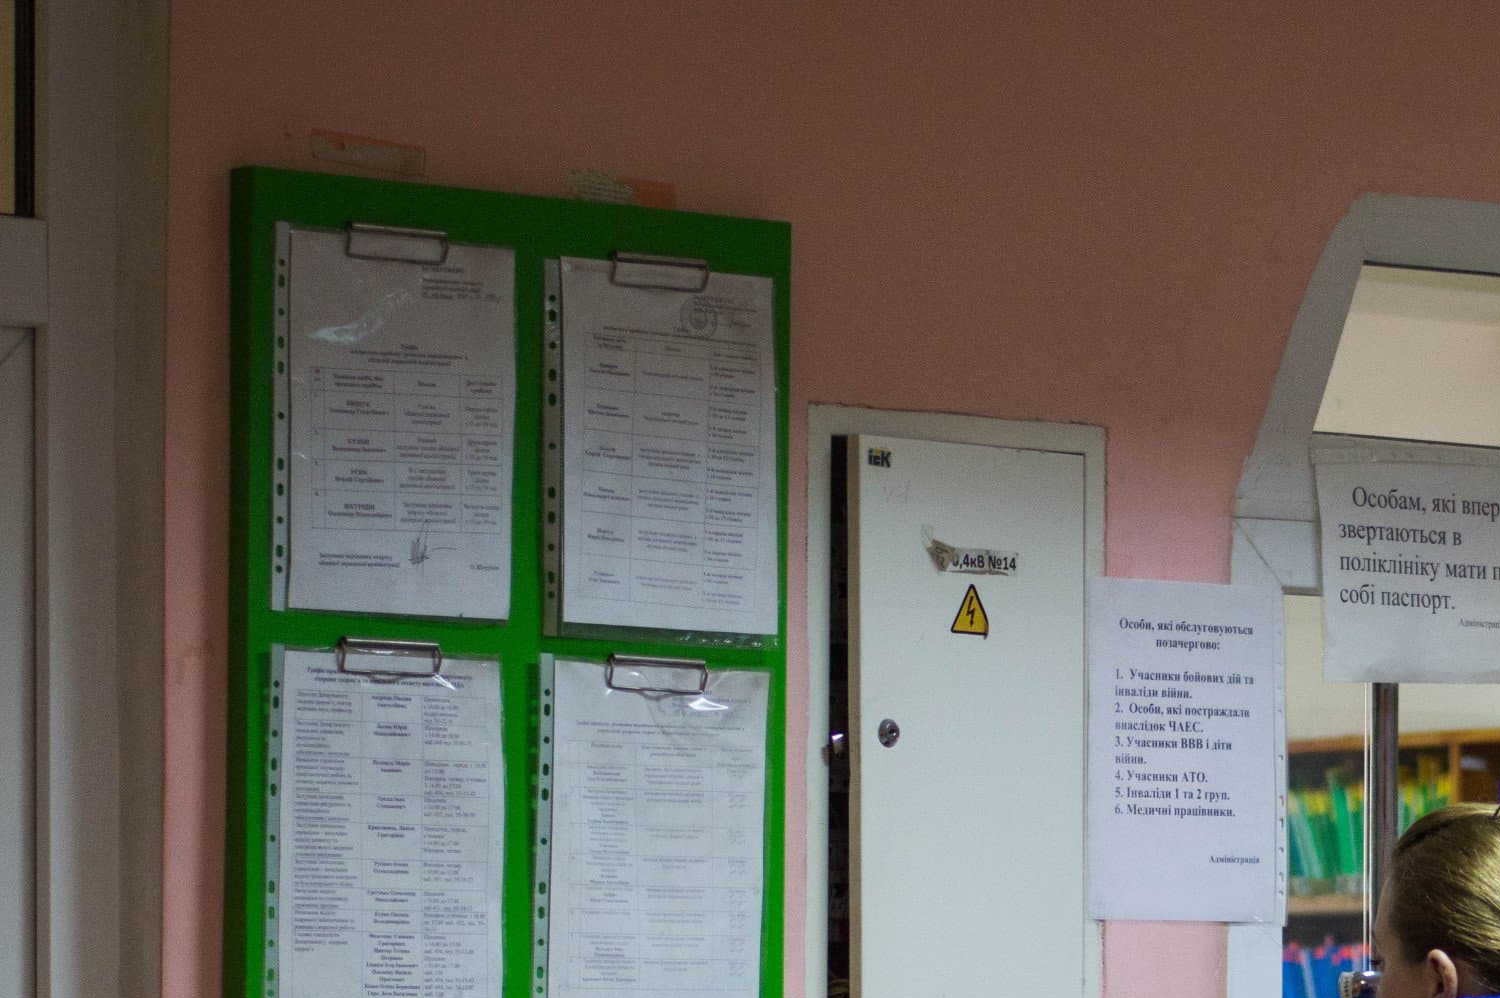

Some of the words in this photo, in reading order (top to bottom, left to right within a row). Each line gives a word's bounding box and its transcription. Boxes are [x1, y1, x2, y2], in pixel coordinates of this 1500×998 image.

[1352, 486, 1426, 513] Особам,
[1432, 493, 1457, 514] які
[1338, 522, 1447, 546] звертаються
[1452, 531, 1463, 546] в
[1339, 551, 1440, 582] поліклініку
[1445, 562, 1487, 580] мати
[1339, 584, 1376, 606] собі
[1381, 590, 1456, 615] паспорт.
[1119, 617, 1155, 631] Особи,
[1157, 620, 1174, 632] які
[1175, 621, 1254, 636] обслуговуються
[1116, 668, 1124, 680] 1.
[1130, 668, 1181, 682] Учасники
[1183, 672, 1225, 684] бойових
[1226, 673, 1242, 686] дій
[1244, 676, 1255, 685] та
[1114, 702, 1124, 714] 2.
[1129, 703, 1164, 716] Особи,
[1166, 704, 1182, 716] які
[1184, 706, 1251, 720] постраждали
[1168, 721, 1204, 734] ЧАЕС.
[1114, 736, 1124, 748] 3.
[1126, 736, 1179, 749] Учасники
[1180, 738, 1204, 750] ВВВ
[1211, 740, 1233, 751] діти
[1114, 770, 1124, 781] 4.
[1127, 770, 1179, 783] Учасники
[1181, 771, 1208, 784] АТО.
[1114, 786, 1124, 799] 5.
[1126, 787, 1172, 800] Інваліди
[1183, 791, 1194, 800] та
[1196, 788, 1203, 801] 2
[1204, 791, 1231, 803] груп.
[1114, 804, 1123, 815] 6.
[1126, 804, 1172, 816] Медичні
[1174, 805, 1236, 819] працівники.
